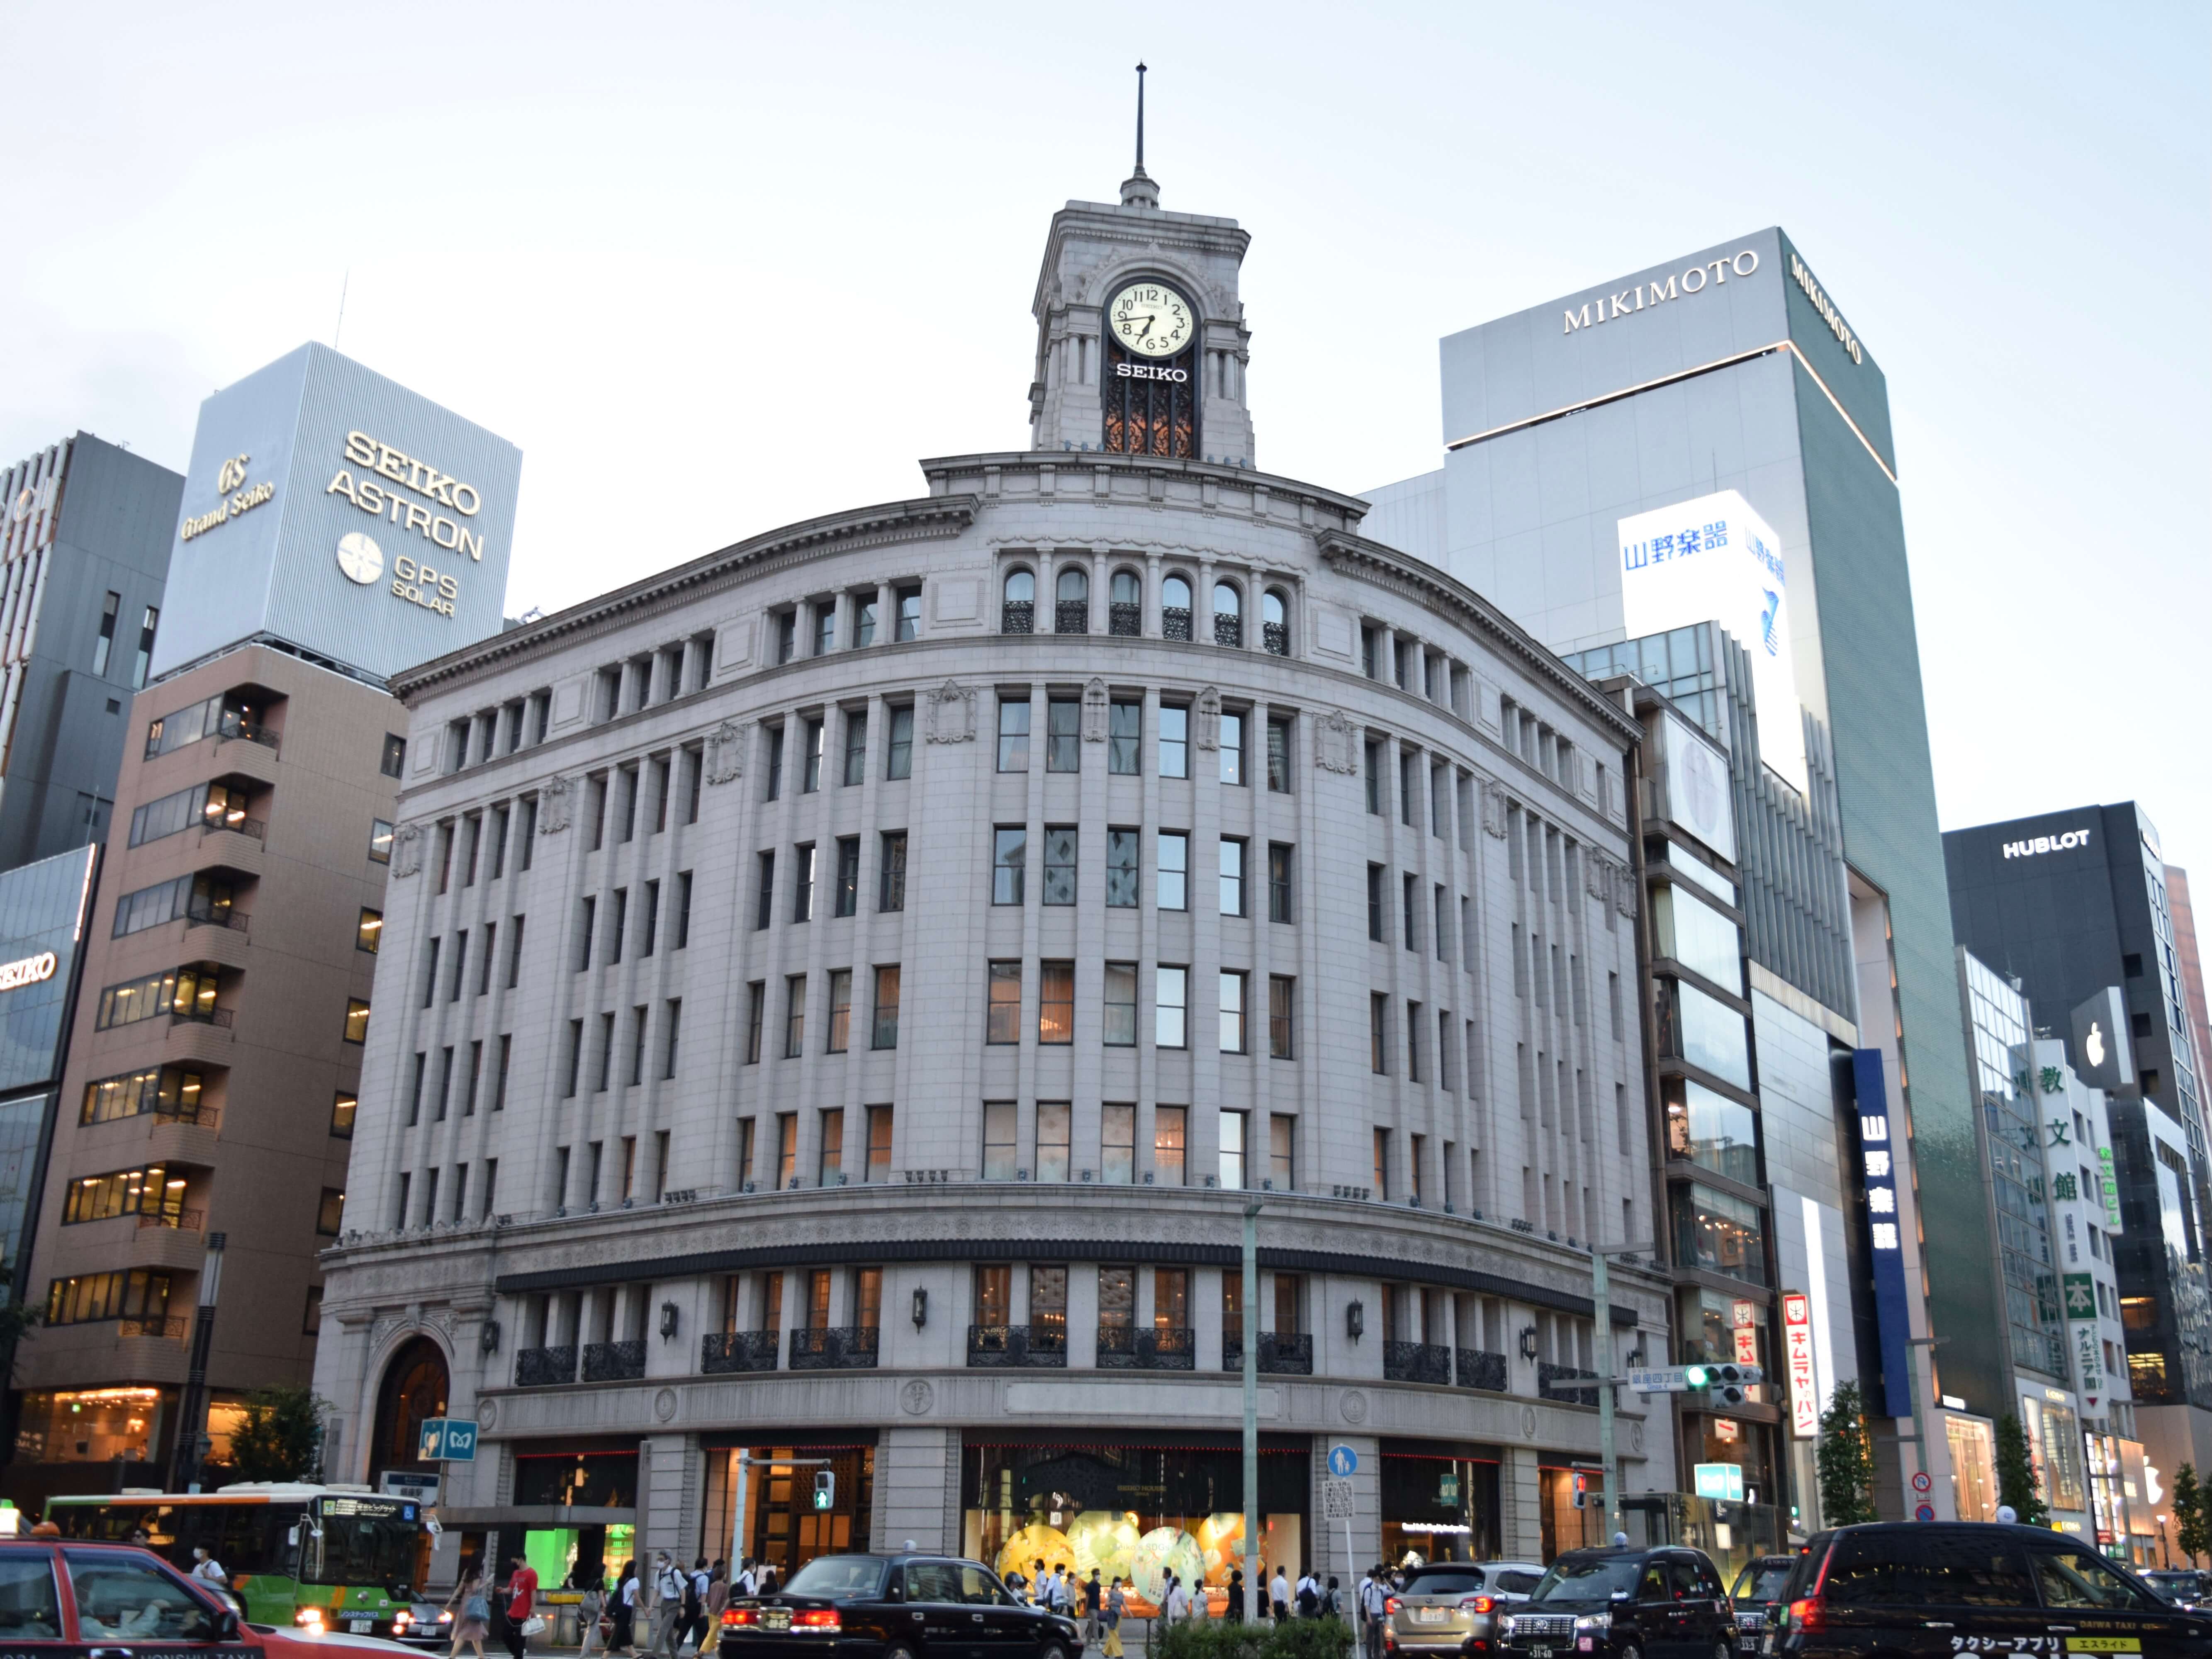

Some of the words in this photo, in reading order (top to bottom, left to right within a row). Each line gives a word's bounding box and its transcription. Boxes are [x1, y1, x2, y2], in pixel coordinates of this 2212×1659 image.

[1134, 291, 1143, 302] 11
[1146, 289, 1158, 301] 12
[1163, 294, 1167, 305] 1
[1564, 250, 1759, 334] MIKIMOTO
[1117, 311, 1128, 320] 9
[1122, 299, 1134, 311] 10
[1171, 304, 1181, 316] 2
[1791, 253, 1862, 365] MIKIMOTO
[1122, 324, 1132, 335] 8
[1170, 329, 1180, 341] 4
[1176, 317, 1185, 329] 3
[1134, 333, 1142, 345] 7
[1146, 338, 1156, 350] 6
[1160, 336, 1169, 348] 5
[1117, 363, 1188, 382] SEIKO
[218, 452, 250, 495] GS
[344, 430, 482, 516] SEIKO
[181, 499, 228, 541] Grand
[230, 480, 275, 517] Seiko
[327, 469, 484, 562] ASTRON
[1623, 520, 1728, 571] 山野楽器
[1744, 524, 1786, 587] 山野楽器
[394, 555, 458, 600] GPS
[391, 580, 456, 618] SOLAR
[2003, 829, 2090, 859] HUBLOT
[2039, 1065, 2077, 1201] 教文館
[1861, 1115, 1898, 1250] 山野楽器
[2098, 1146, 2120, 1225] 教文館ビル
[2066, 1280, 2092, 1312] 本
[2077, 1327, 2097, 1390] ナルニア国
[1632, 1373, 1683, 1384] 銀座四丁目
[1791, 1331, 1814, 1428] キムラヤのパン
[2080, 1620, 2111, 1629] DAIWA
[2115, 1621, 2136, 1630] TAXI
[1950, 1635, 2059, 1652] タクシーアプリ
[2079, 1640, 2127, 1649] エスライド
